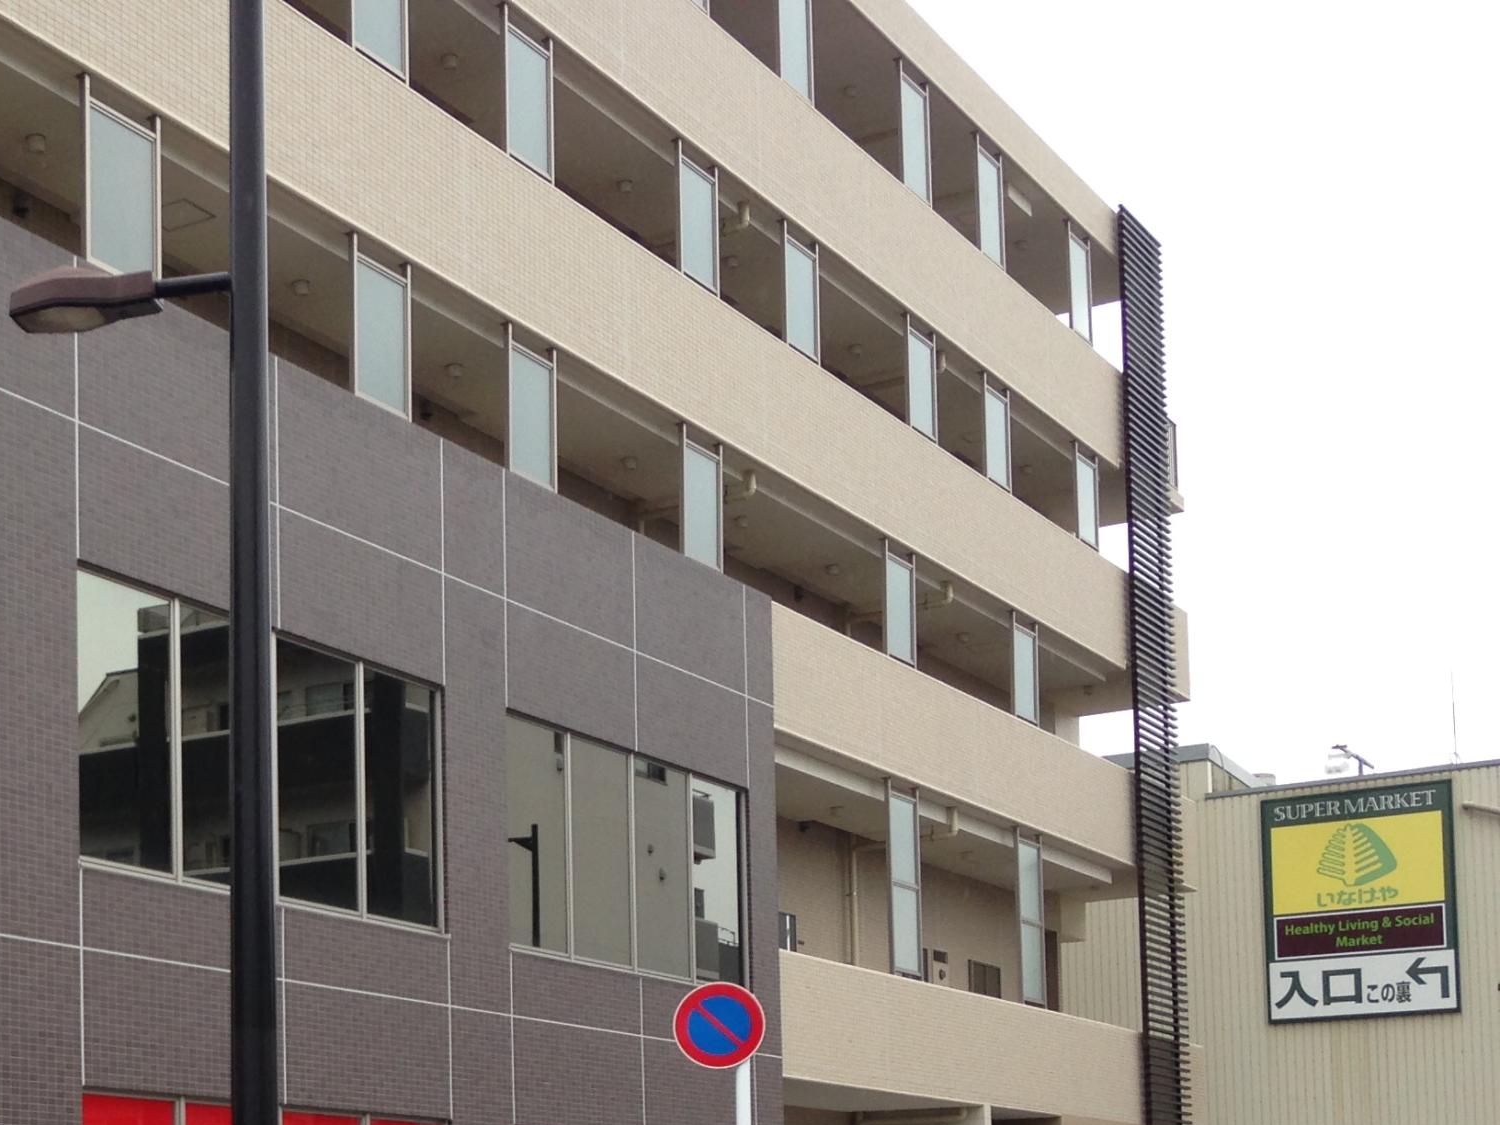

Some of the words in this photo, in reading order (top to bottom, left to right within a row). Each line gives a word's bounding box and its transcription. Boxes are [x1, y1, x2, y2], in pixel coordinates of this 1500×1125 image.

[1274, 800, 1341, 822] SUPER
[1344, 789, 1437, 815] MARKET
[1284, 922, 1336, 936] Healthy
[1338, 919, 1379, 932] Living
[1381, 916, 1392, 928] &
[1394, 913, 1435, 927] Social
[1335, 934, 1384, 948] Market
[1274, 968, 1364, 1010] 入口
[1366, 981, 1413, 1004] この裏
